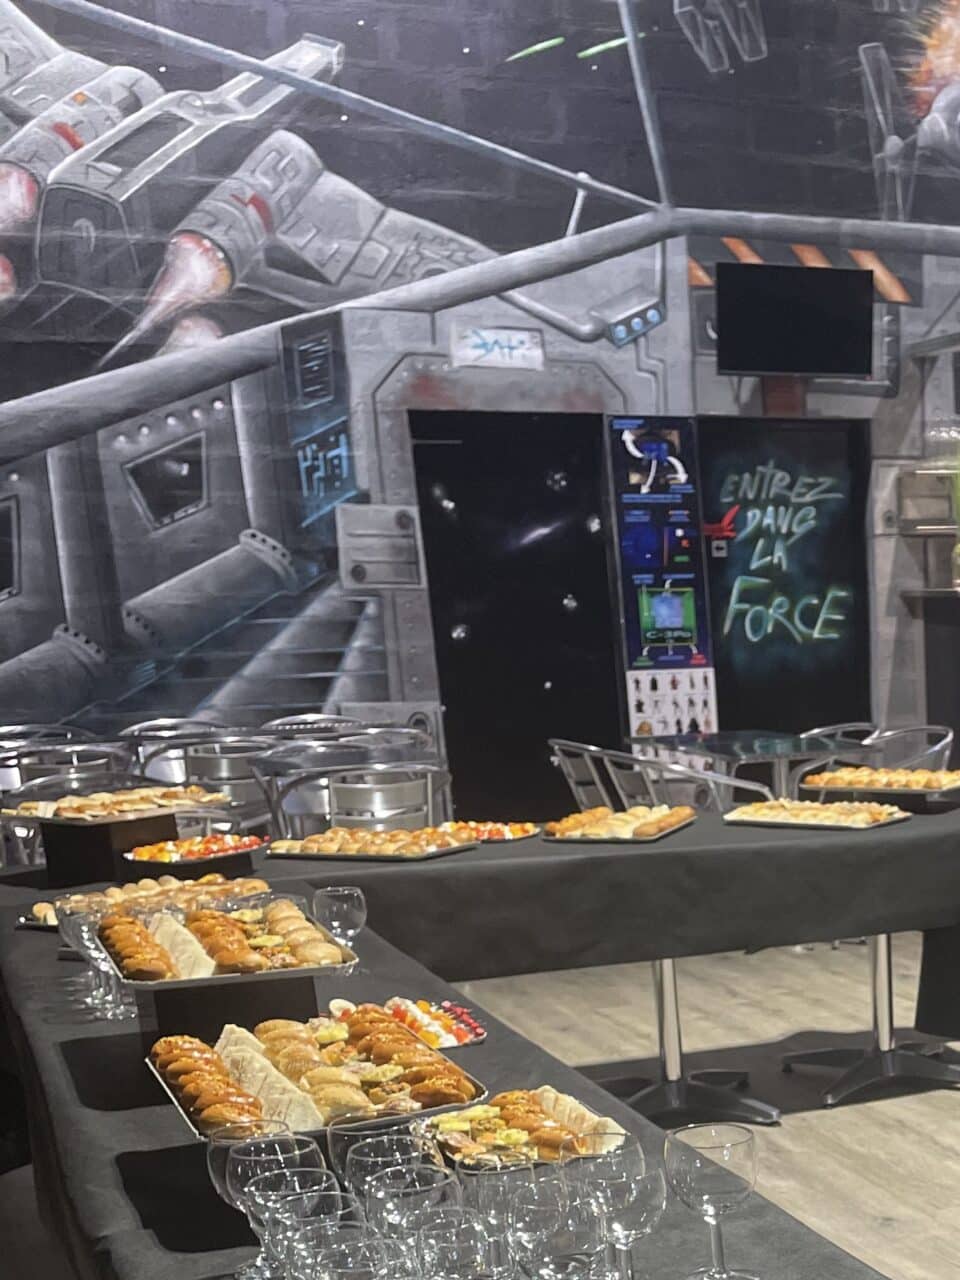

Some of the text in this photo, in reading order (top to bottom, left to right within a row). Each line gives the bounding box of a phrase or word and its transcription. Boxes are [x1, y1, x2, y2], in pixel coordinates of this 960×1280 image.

[719, 461, 845, 503] ENTREZ
[750, 538, 788, 571] LA
[723, 576, 850, 644] FORCE
